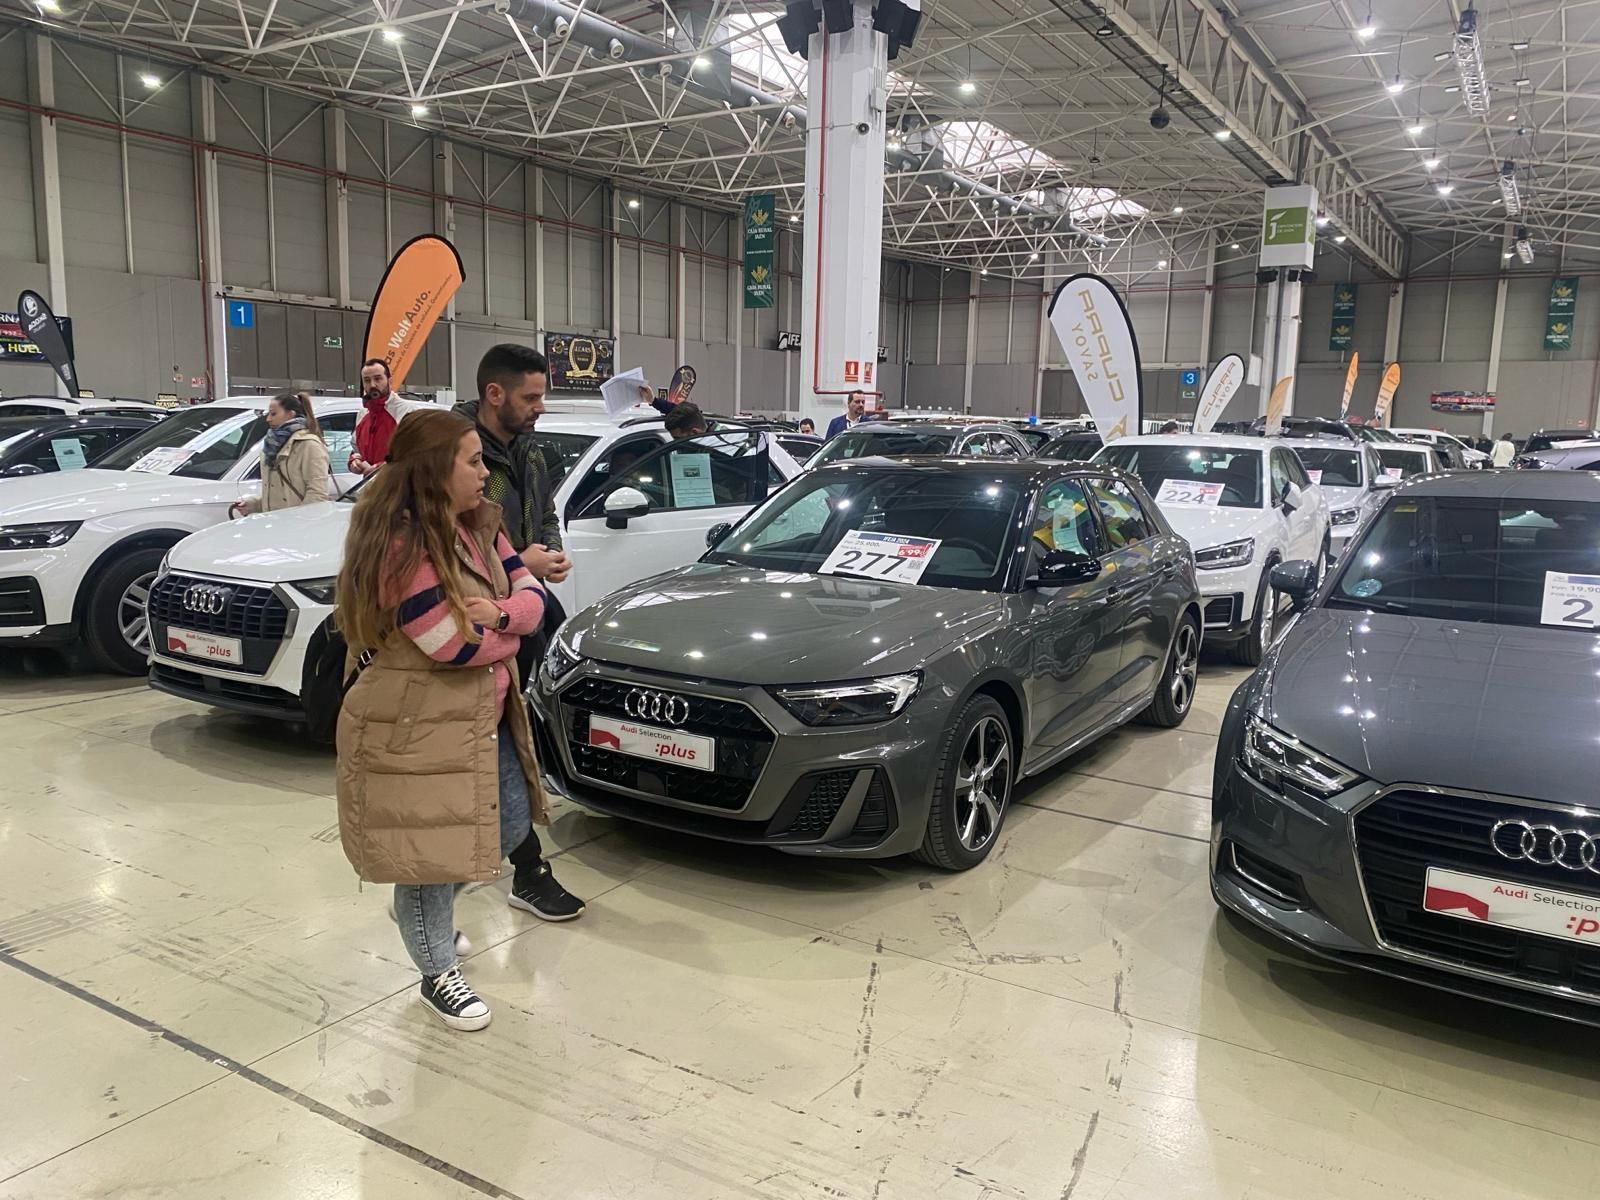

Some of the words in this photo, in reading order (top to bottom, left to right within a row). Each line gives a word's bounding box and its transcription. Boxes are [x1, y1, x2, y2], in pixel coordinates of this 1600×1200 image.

[237, 305, 246, 325] 1
[787, 333, 801, 347] IFE
[384, 350, 396, 366] as
[1186, 372, 1195, 384] 3
[1202, 361, 1236, 418] CUPRA
[1215, 380, 1233, 409] SAVOY
[1164, 490, 1206, 504] 224
[835, 550, 908, 575] 277
[206, 645, 232, 657] :plus
[620, 724, 638, 734] Audi
[639, 728, 672, 741] Selection
[655, 743, 697, 760] :plus
[1493, 885, 1529, 900] Audi
